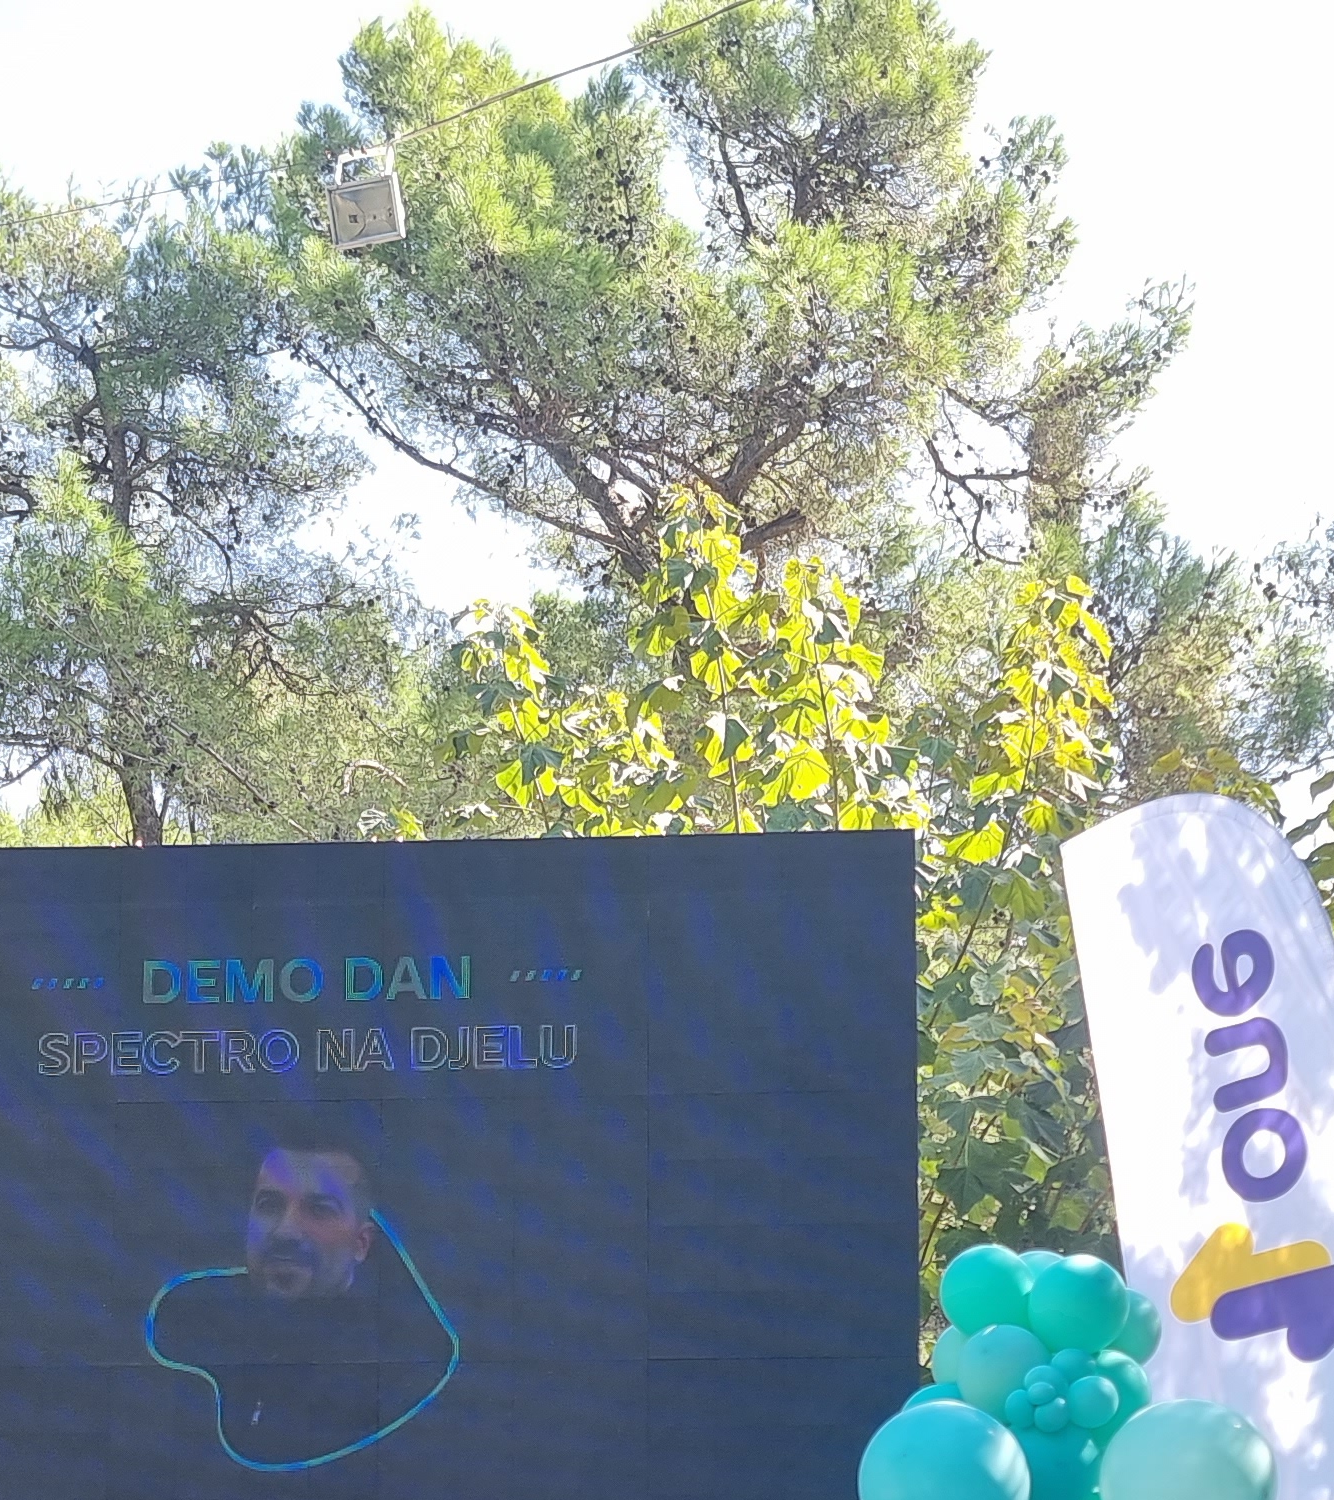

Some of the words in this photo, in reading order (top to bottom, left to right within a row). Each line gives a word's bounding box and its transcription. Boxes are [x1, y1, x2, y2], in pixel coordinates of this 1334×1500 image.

[141, 956, 324, 1004] DEMO
[345, 955, 472, 1001] DAN
[38, 1028, 301, 1076] SPECTRO
[315, 1028, 396, 1073] NA
[410, 1024, 579, 1072] DJELU
[1191, 929, 1308, 1203] one
